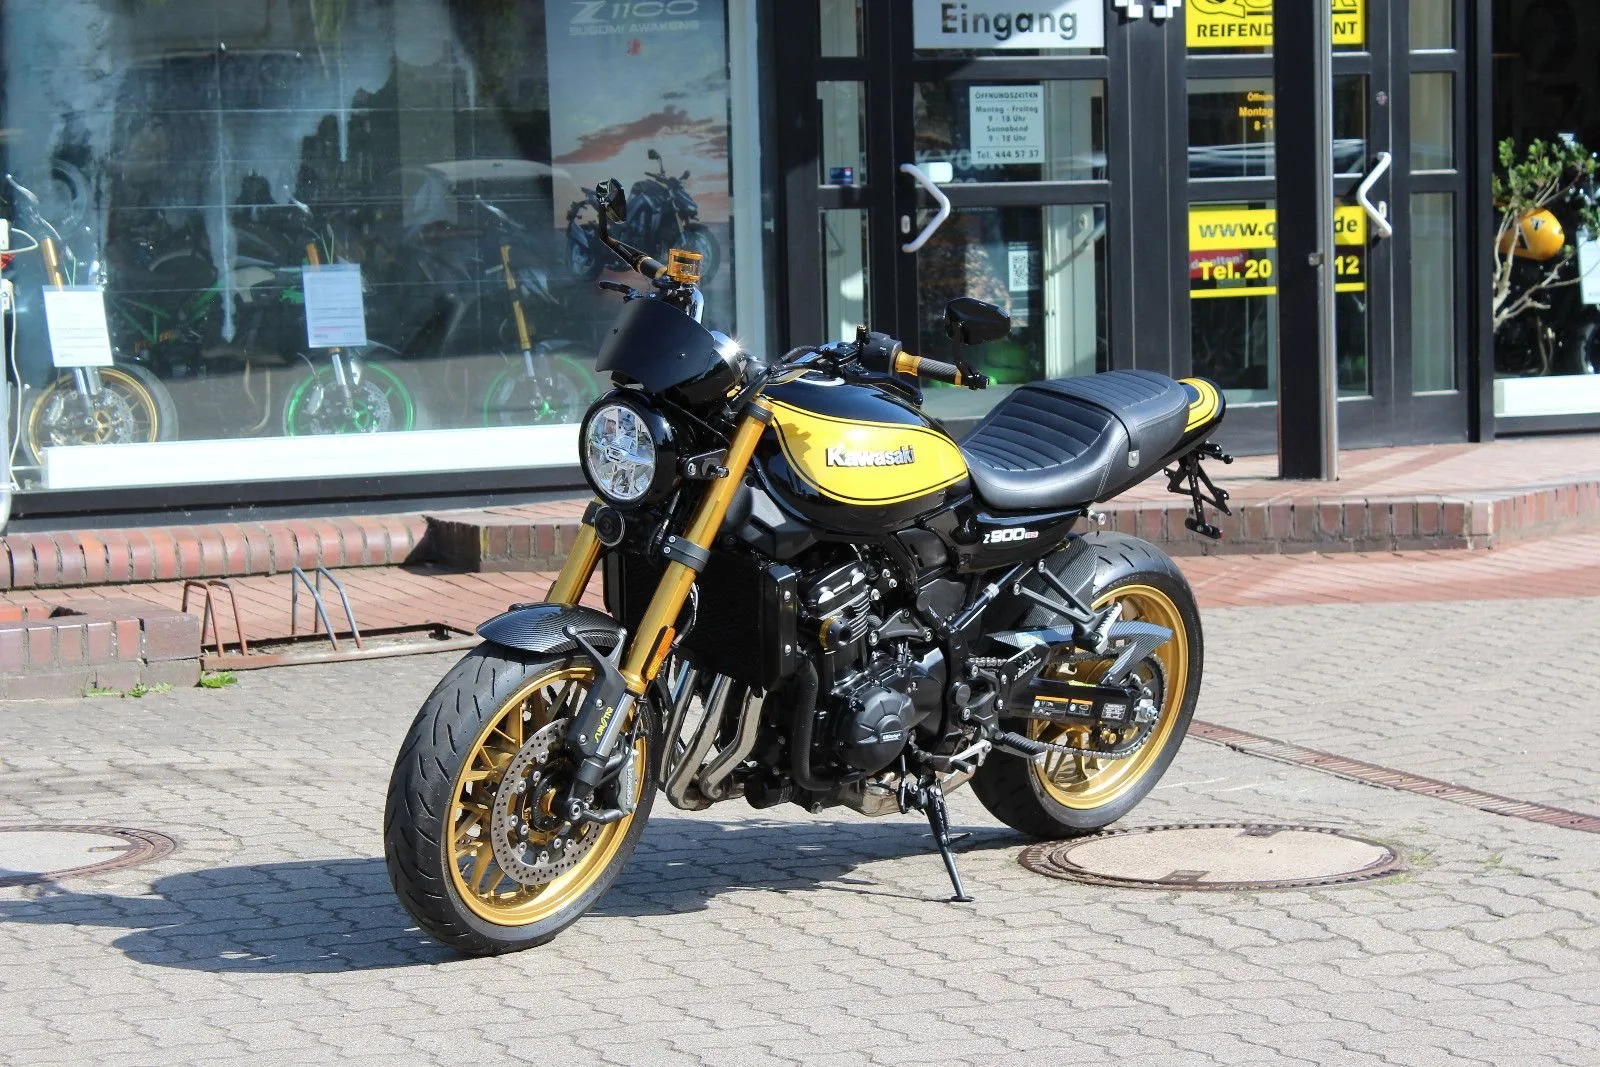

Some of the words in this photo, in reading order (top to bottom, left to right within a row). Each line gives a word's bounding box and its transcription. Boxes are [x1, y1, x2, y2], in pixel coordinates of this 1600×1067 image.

[629, 20, 699, 33] AWAKENS
[941, 2, 1077, 41] Eingang
[975, 91, 1038, 99] ÖFFNUNGSZEITEN
[975, 106, 1004, 114] Montag
[1012, 105, 1038, 114] Freitag
[1199, 260, 1241, 280] Tel.
[825, 445, 915, 467] Kawasaki
[594, 706, 614, 744] SUNSTAR
